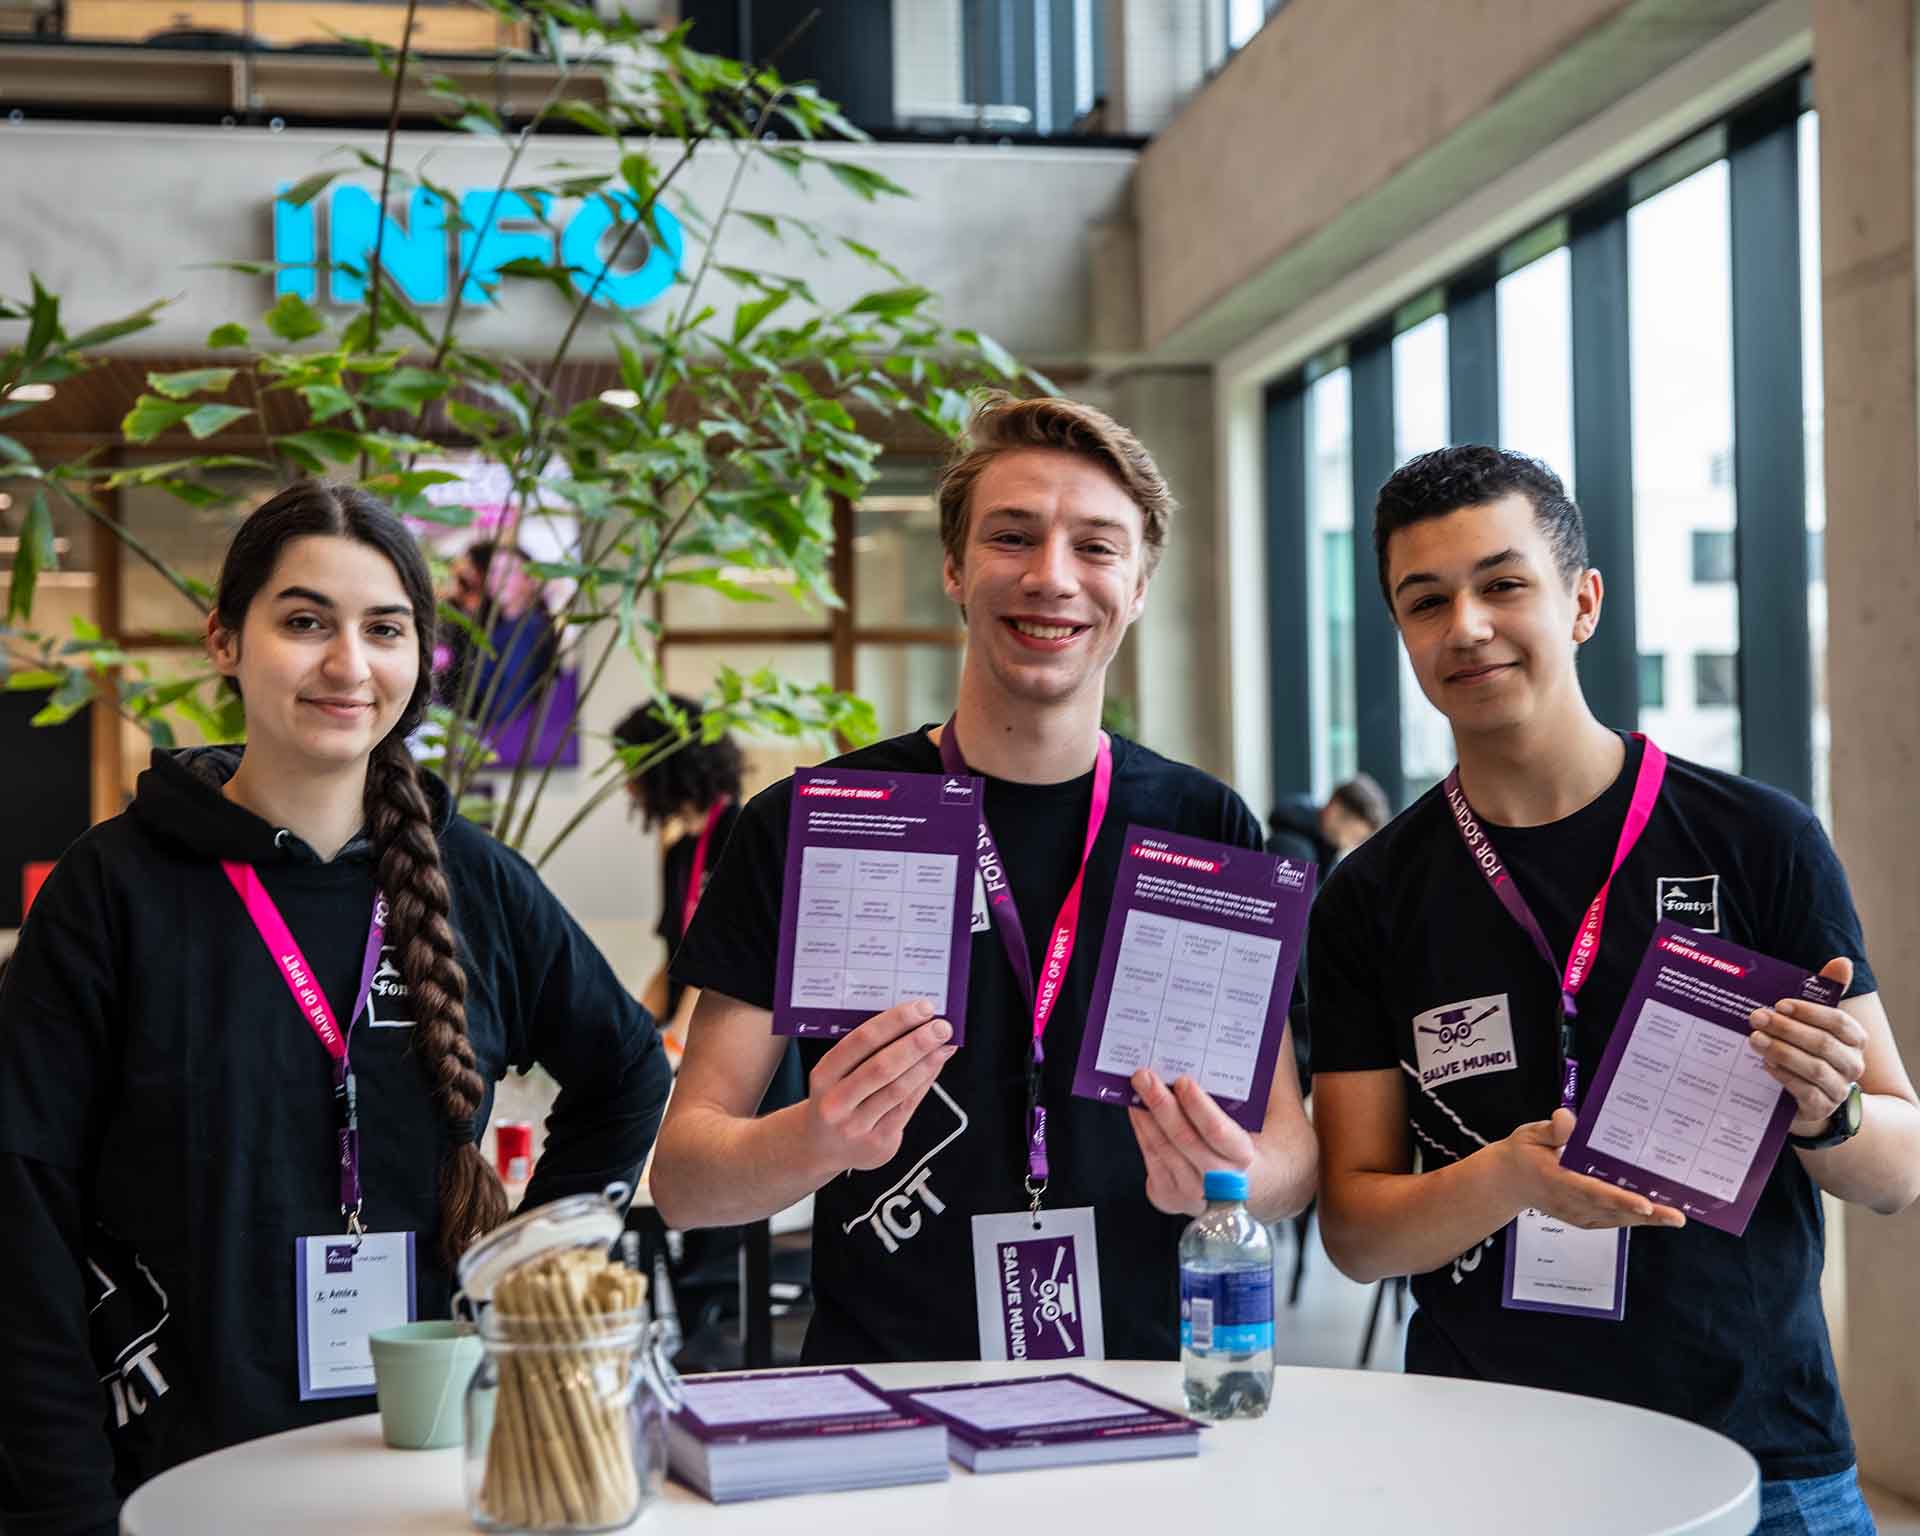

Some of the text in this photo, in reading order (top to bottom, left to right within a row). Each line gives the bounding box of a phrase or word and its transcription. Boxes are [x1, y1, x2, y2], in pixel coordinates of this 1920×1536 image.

[273, 181, 686, 310] INFO
[808, 788, 841, 797] FONTYS
[856, 790, 884, 799] BINGO
[1447, 787, 1502, 878] FOR SOCIETY
[978, 852, 1006, 892] FOR
[1140, 848, 1214, 872] FONTYS ICT BINGO
[1662, 899, 1713, 915] Fontys
[1038, 927, 1071, 1018] MADE OF RPET
[1568, 949, 1590, 986] MADE
[1580, 930, 1596, 947] OF
[1666, 942, 1698, 960] FONTYS
[1713, 957, 1741, 975] BINGO
[282, 953, 336, 1044] MADE OF RPET
[372, 978, 408, 997] Fon
[1423, 1050, 1512, 1084] SALVE MUNDI
[869, 1166, 947, 1254] ICT
[1003, 1246, 1028, 1360] SALVE MUND
